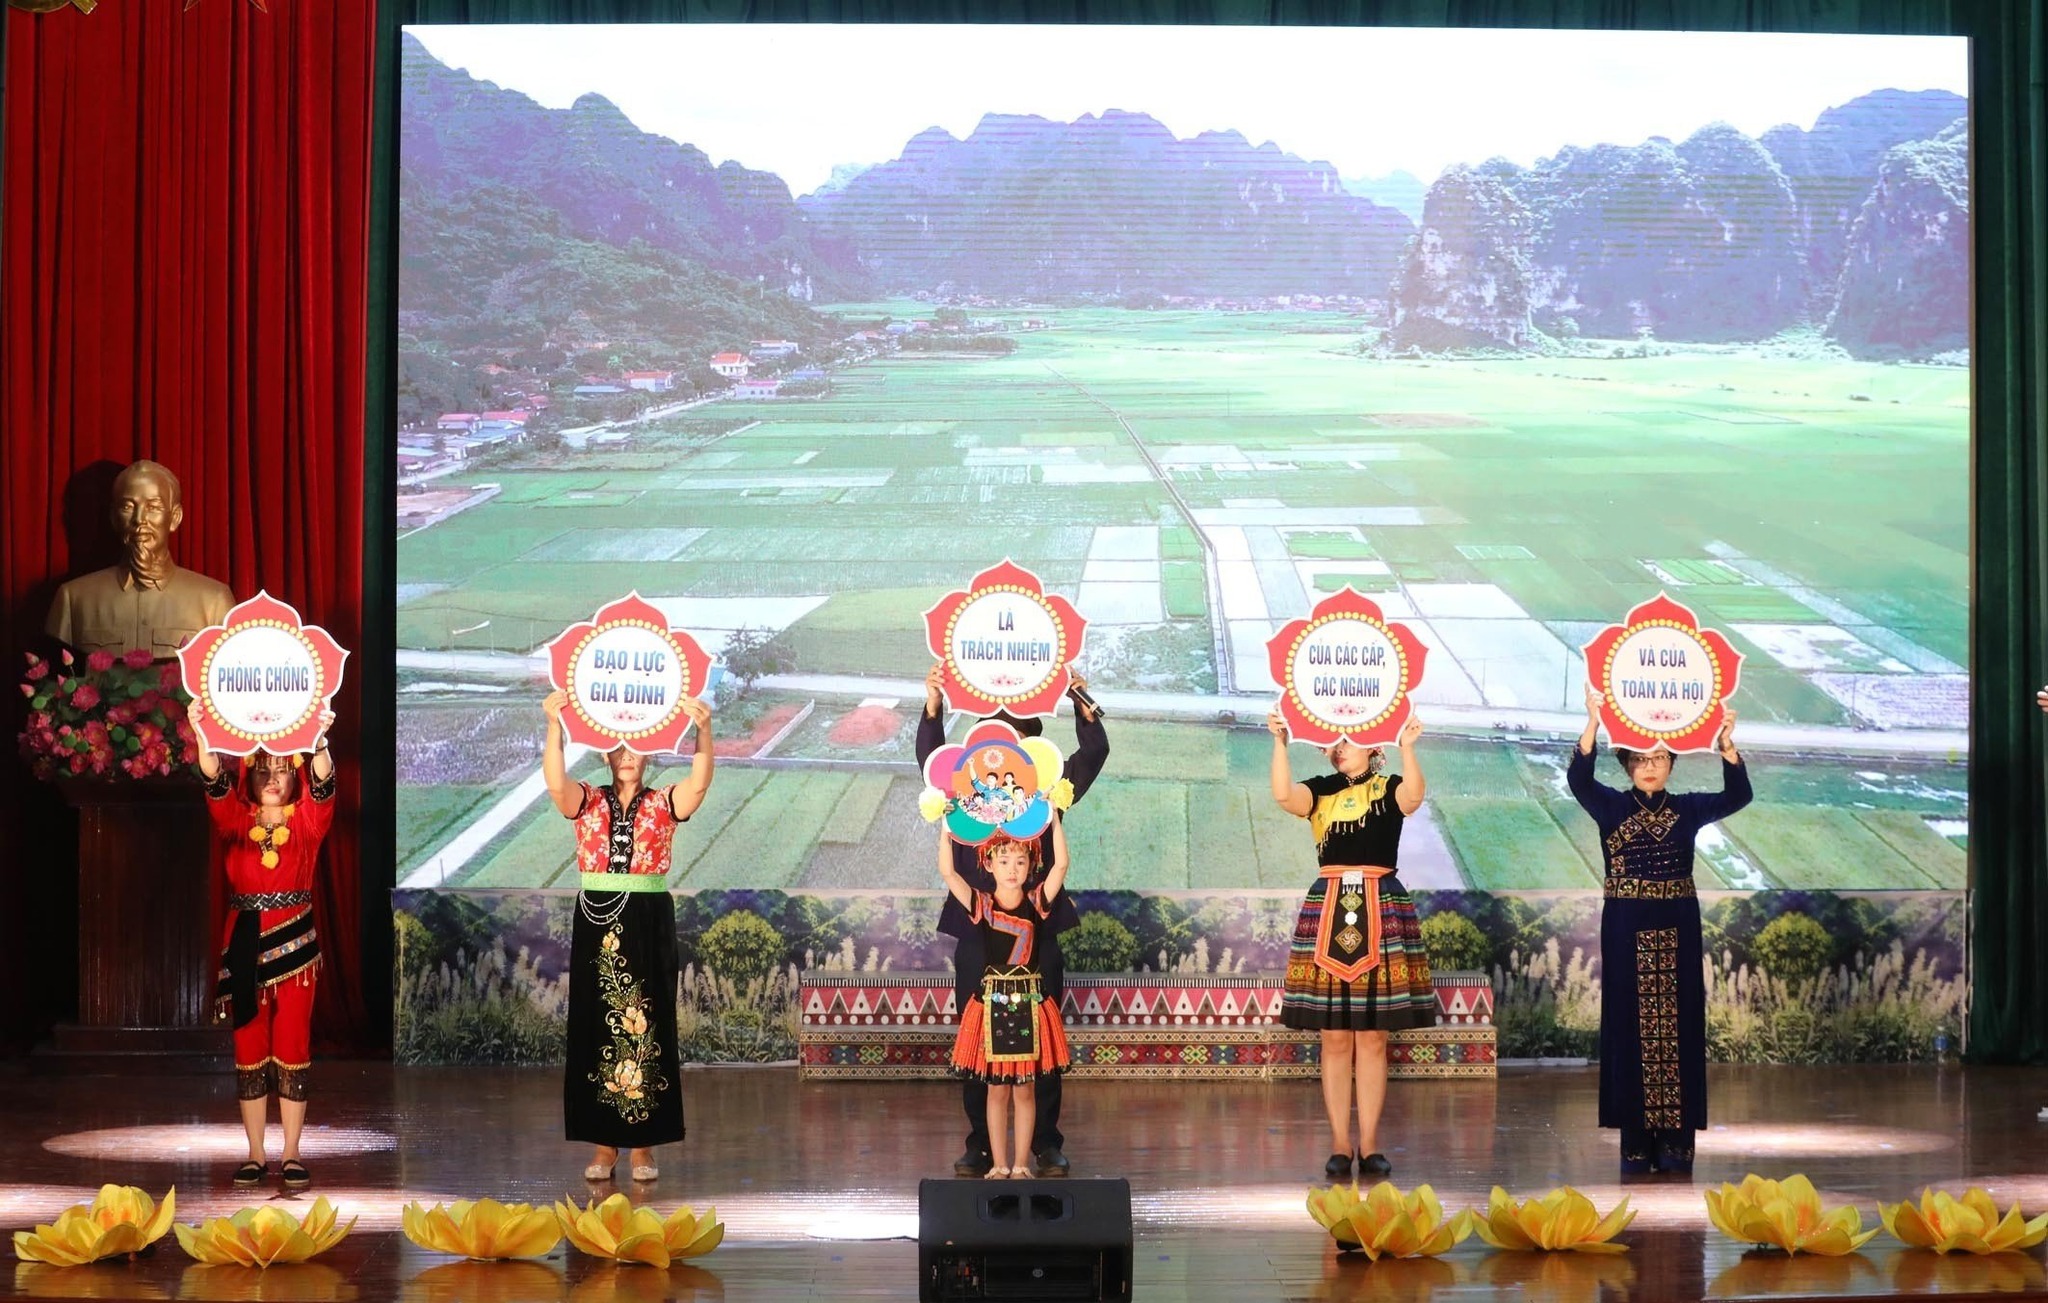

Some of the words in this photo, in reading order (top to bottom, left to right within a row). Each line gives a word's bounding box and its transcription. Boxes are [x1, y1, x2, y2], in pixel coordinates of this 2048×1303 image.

[998, 607, 1014, 631] LÀ
[594, 649, 628, 674] BẠO
[634, 650, 665, 677] LỰC
[961, 636, 1003, 660] TRÁCH
[1007, 638, 1050, 666] NHIỆM
[1309, 639, 1332, 665] CỦA
[1335, 641, 1358, 666] CÁC
[1639, 645, 1656, 667] VÀ
[1660, 643, 1687, 668] CỦA
[218, 661, 261, 692] PHÒNG
[265, 657, 309, 692] CHỐNG
[1314, 672, 1337, 696] CÁC
[1340, 673, 1380, 697] NGÀNH
[590, 682, 618, 703] GIA
[624, 680, 665, 705] ĐÌNH
[1622, 676, 1656, 699] TOÀN
[1660, 678, 1678, 700] XÃ
[1682, 678, 1704, 705] HỘI
